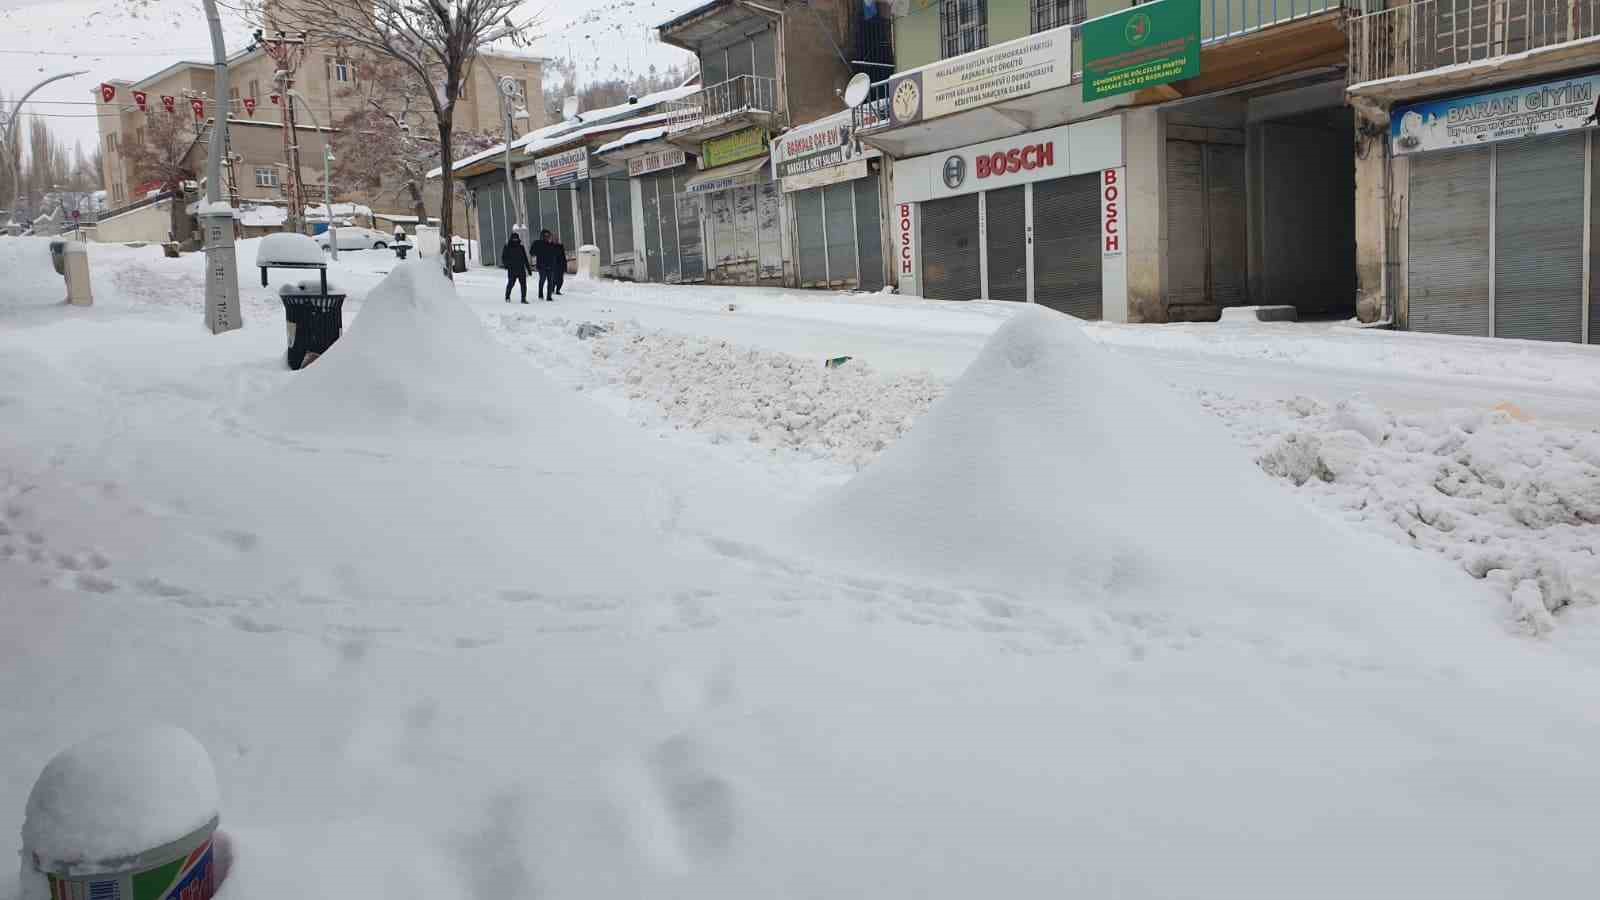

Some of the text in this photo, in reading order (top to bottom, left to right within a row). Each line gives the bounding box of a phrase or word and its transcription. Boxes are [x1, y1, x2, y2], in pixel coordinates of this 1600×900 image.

[1447, 81, 1592, 123] BARAN GİYİM
[976, 141, 1054, 179] BOSCH
[1104, 168, 1118, 251] BOSCH
[901, 204, 912, 274] BOSCH
